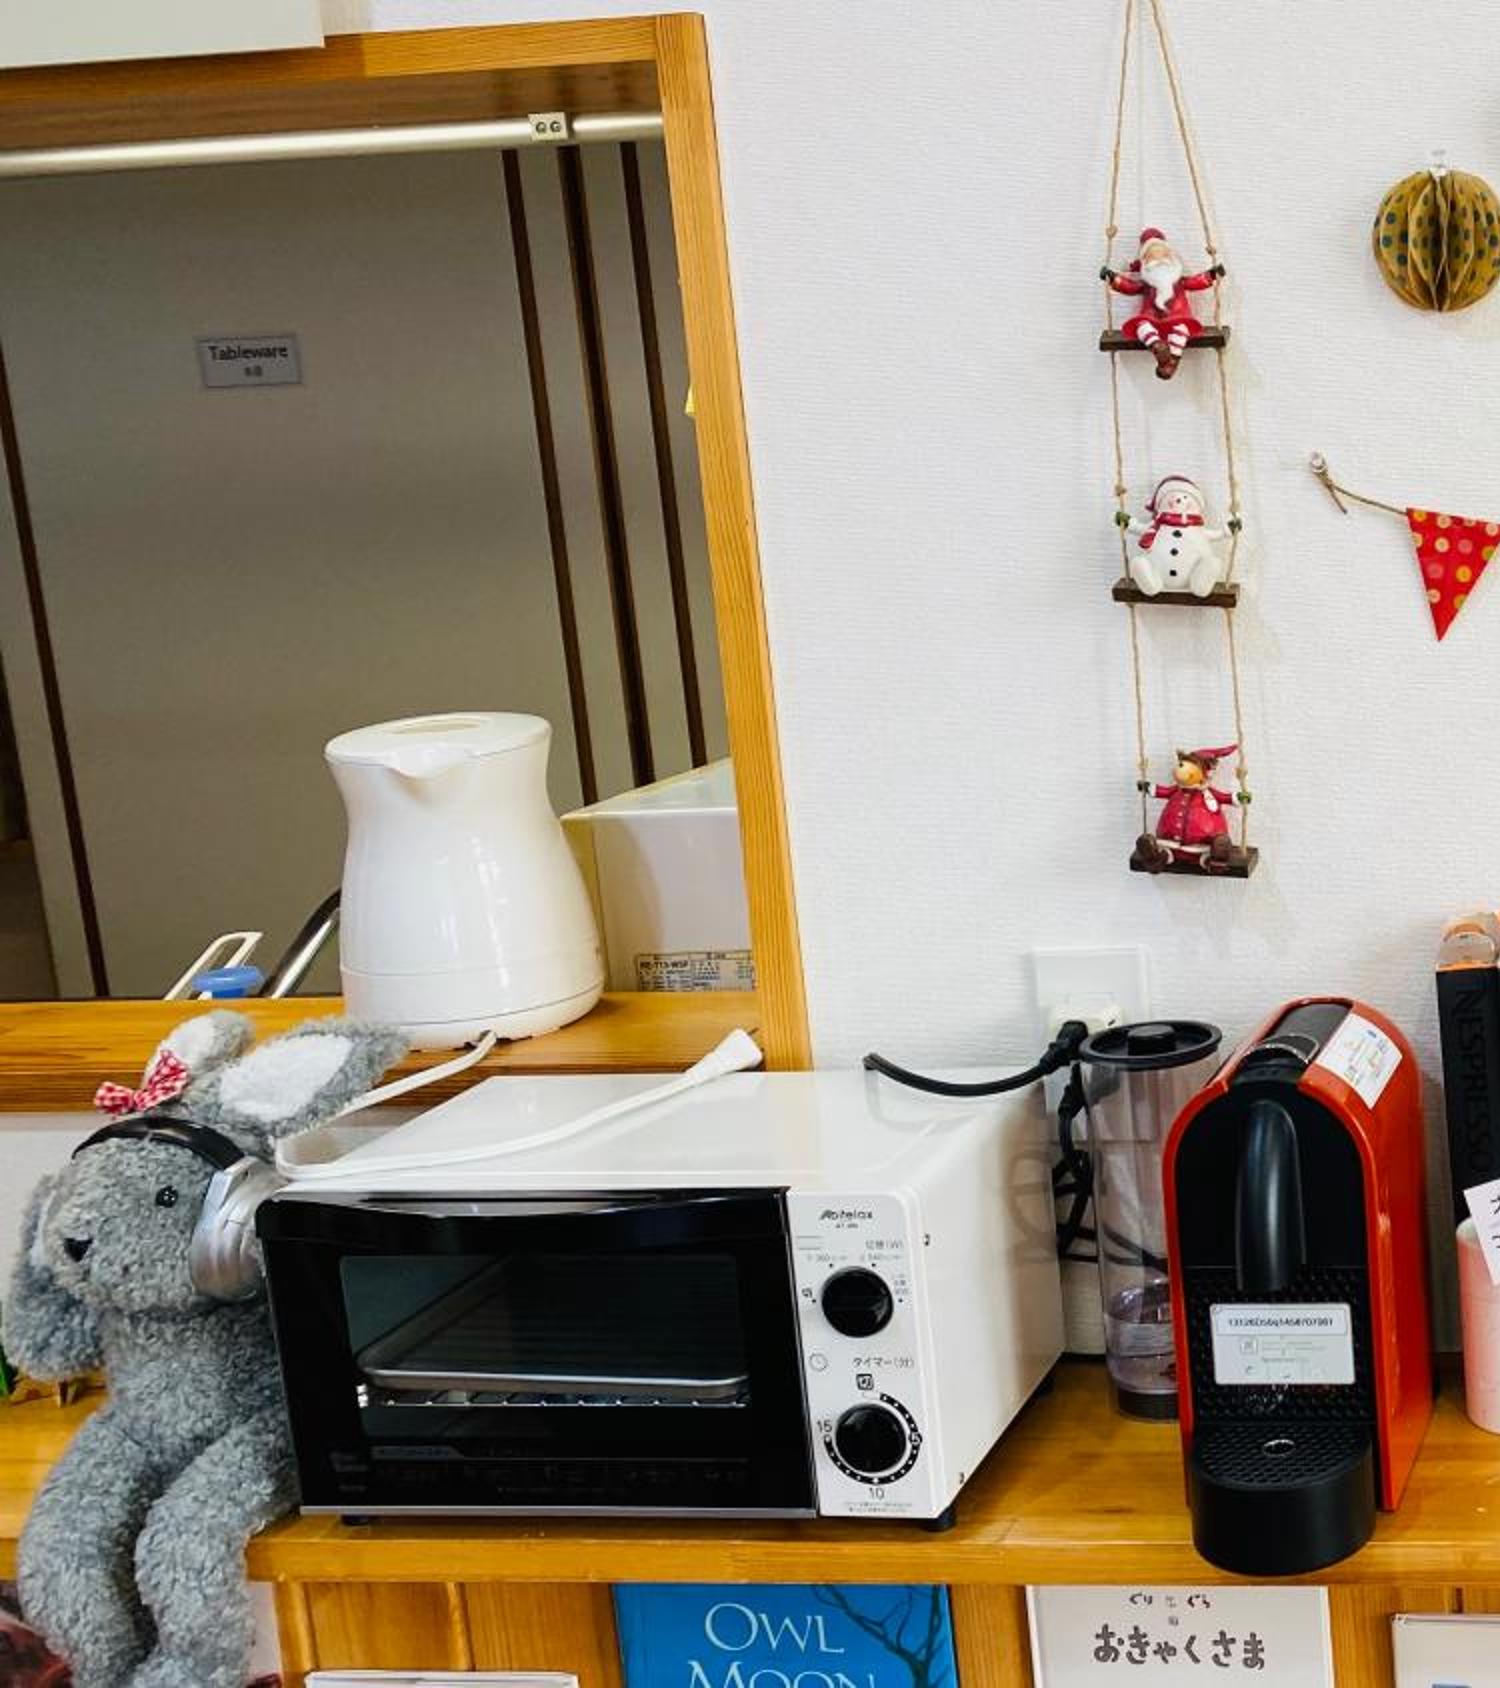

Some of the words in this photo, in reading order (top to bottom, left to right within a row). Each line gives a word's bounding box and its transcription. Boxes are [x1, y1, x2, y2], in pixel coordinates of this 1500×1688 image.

[208, 346, 289, 361] Tableware
[817, 1420, 833, 1433] 15
[868, 1487, 885, 1501] 10
[705, 1602, 845, 1653] OWL
[1093, 1623, 1265, 1671] おきゃくさま
